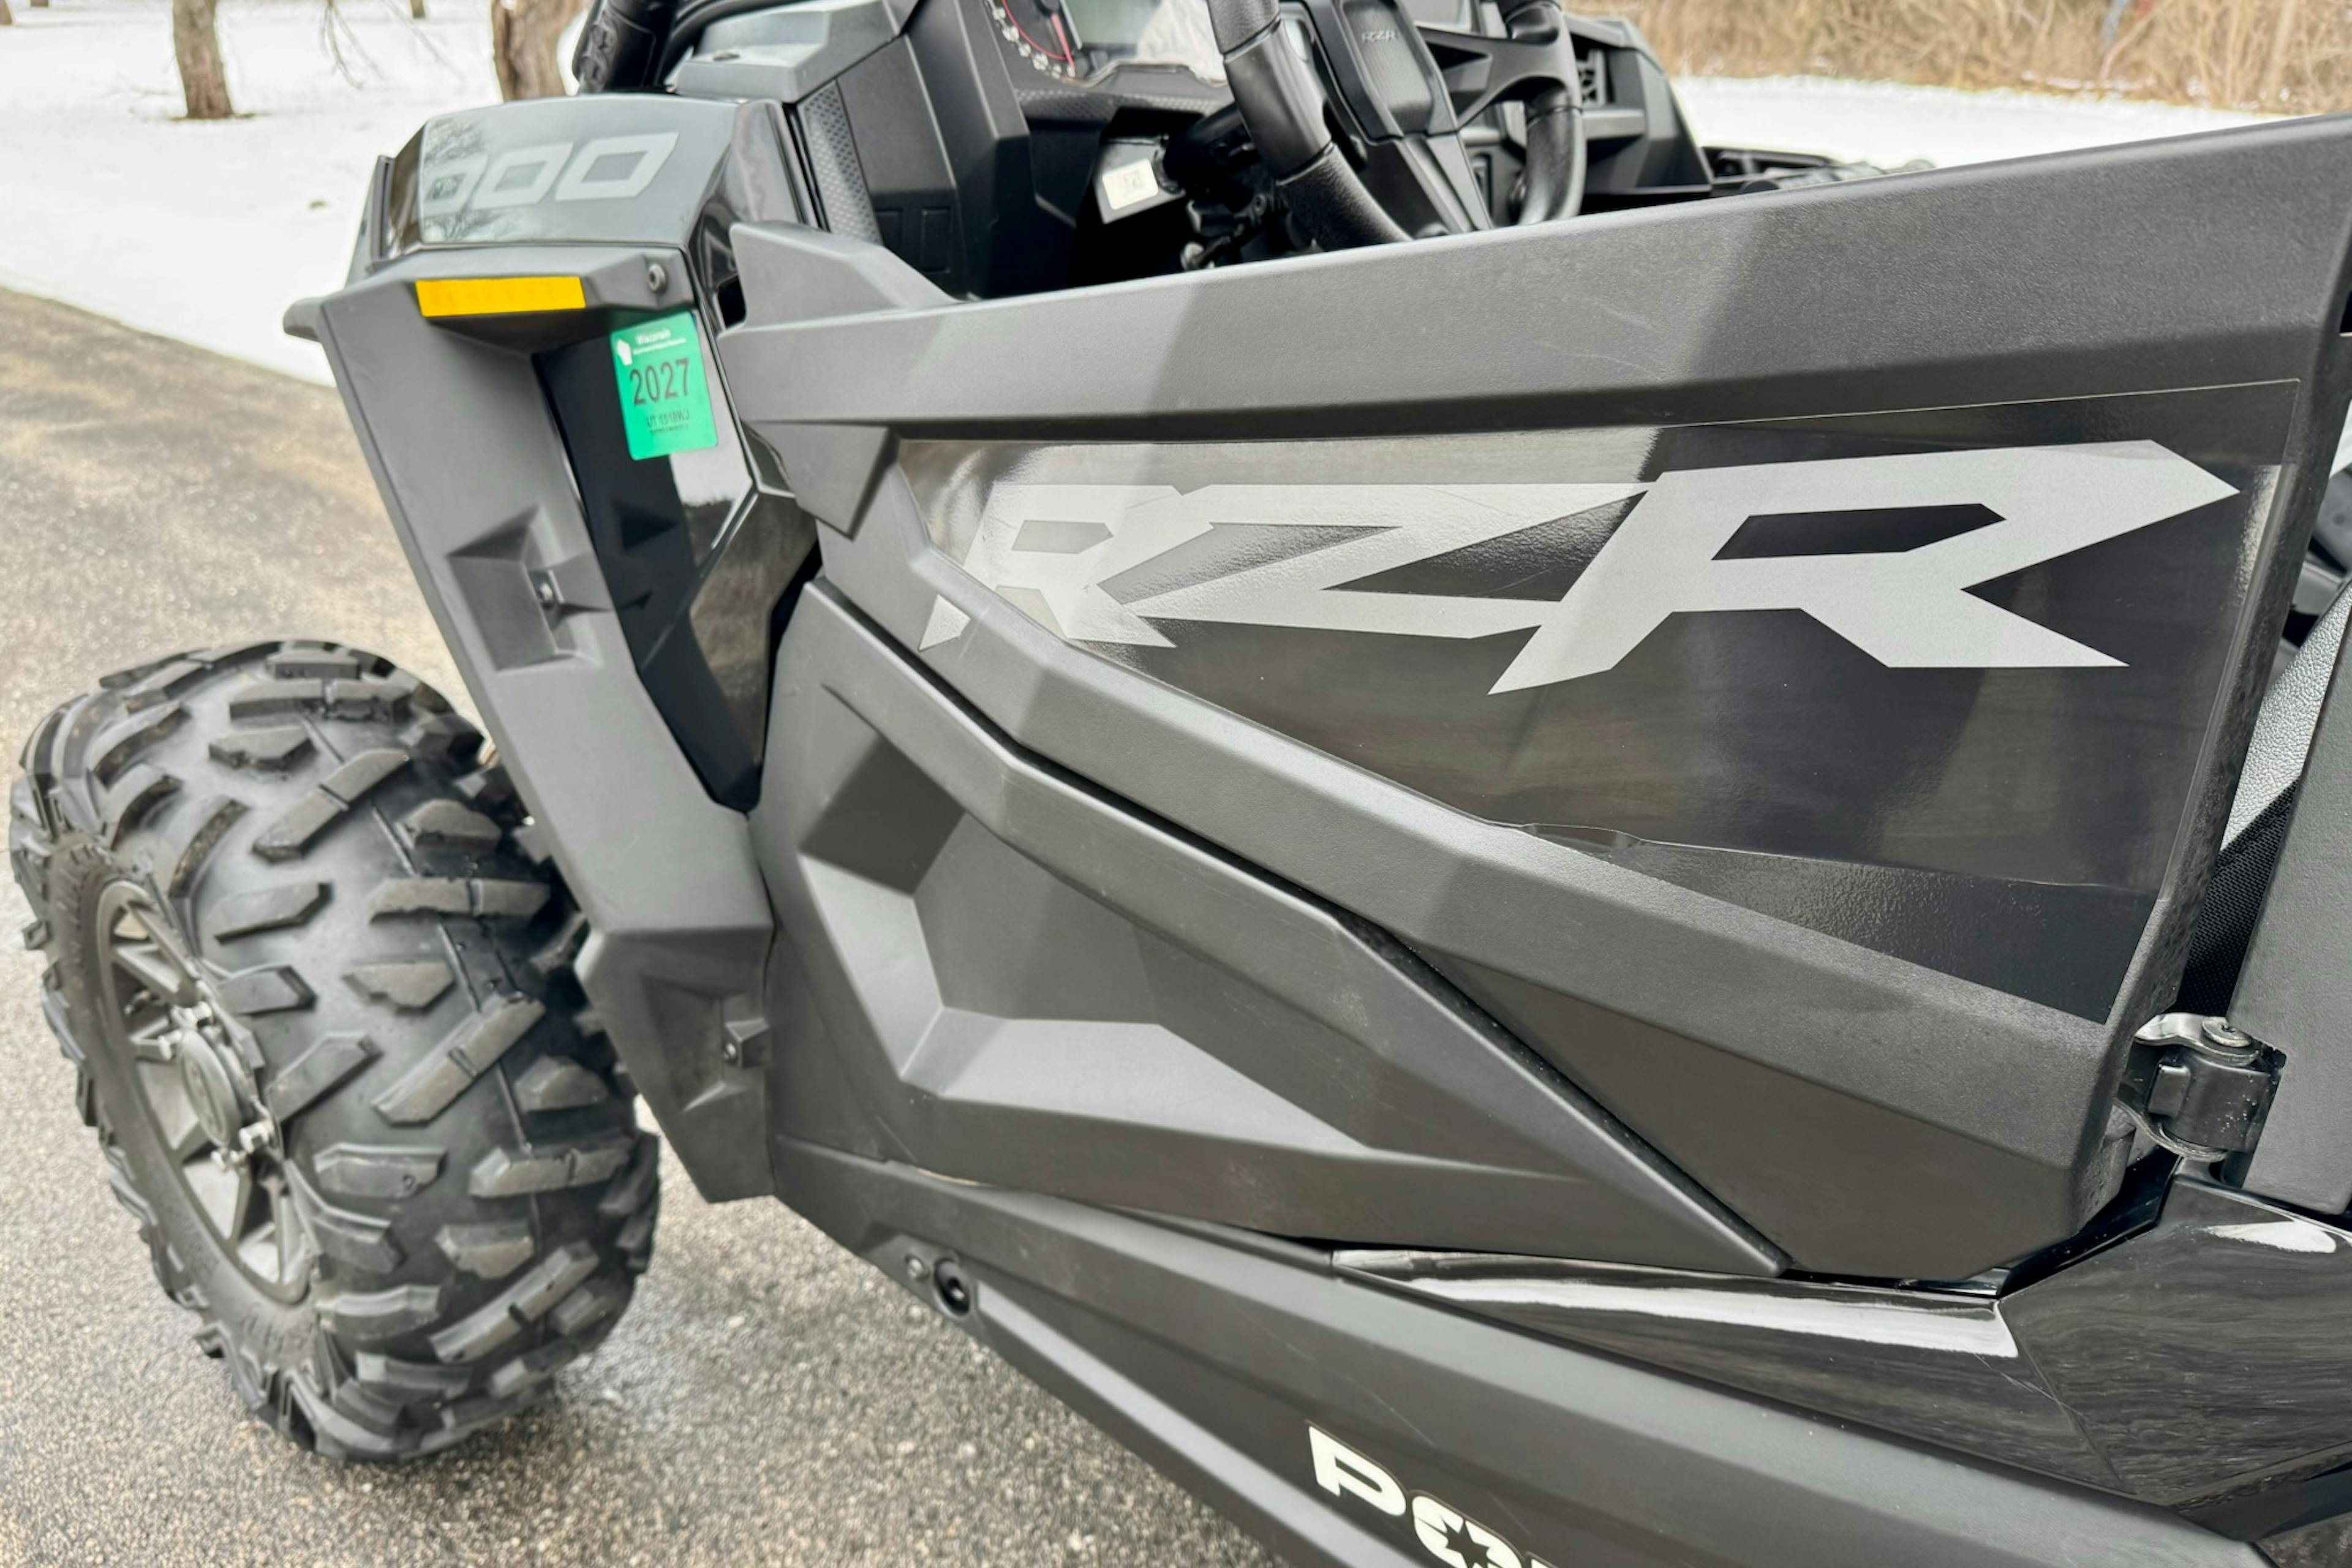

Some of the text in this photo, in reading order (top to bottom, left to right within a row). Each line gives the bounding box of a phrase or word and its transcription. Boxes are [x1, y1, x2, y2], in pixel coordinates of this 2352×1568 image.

[629, 358, 690, 406] 2027
[919, 439, 2240, 695] RZR
[1308, 1425, 1551, 1568] PO
